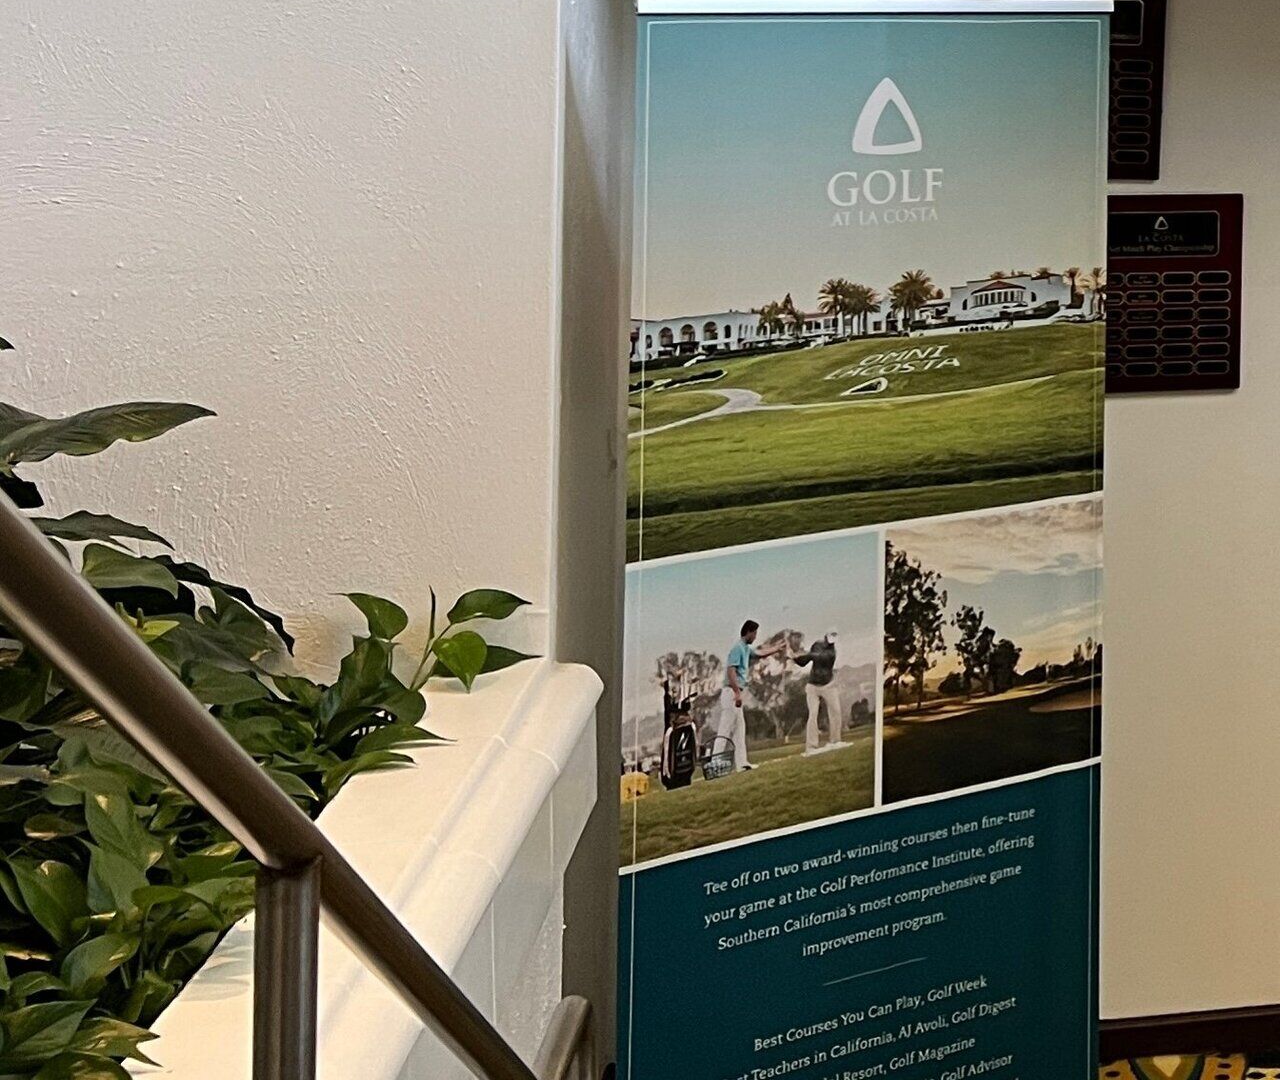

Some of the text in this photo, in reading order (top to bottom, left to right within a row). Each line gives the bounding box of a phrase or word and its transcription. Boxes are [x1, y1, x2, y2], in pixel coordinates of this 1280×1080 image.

[827, 168, 944, 207] GOLF
[832, 206, 938, 227] AT LA COSTA
[859, 345, 949, 366] OMNI
[703, 808, 1036, 896] Tee off on two award-winning courses then fine-tune
[703, 834, 1035, 929] your game at the Golf Performance Institute, offering
[718, 863, 1023, 951] Southern California's most comprehensive game
[801, 925, 890, 957] improvement
[754, 974, 988, 1053] Best Courses You Can Play, Golf Week
[751, 1055, 811, 1080] Teachers
[814, 1050, 828, 1065] in
[830, 1030, 897, 1059] California,
[898, 1023, 912, 1040] AJ
[951, 1006, 977, 1025] Golf
[978, 996, 1017, 1016] Digest
[889, 1050, 916, 1071] Golf
[917, 1037, 977, 1062] Magazine
[941, 1053, 1014, 1080] Golf Advisor
